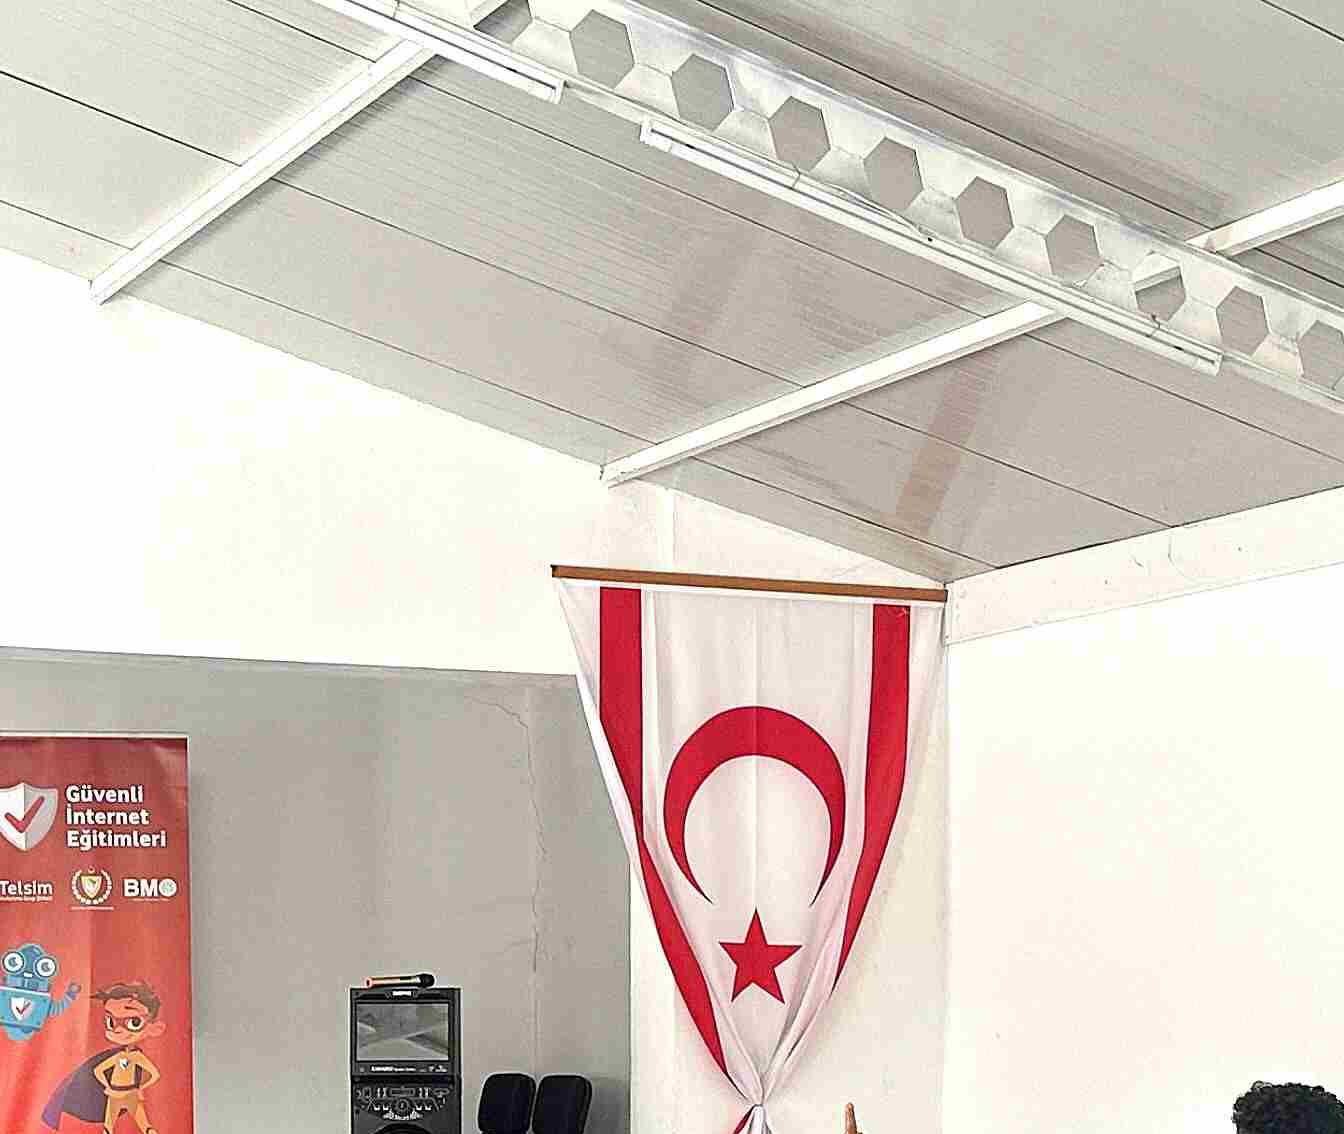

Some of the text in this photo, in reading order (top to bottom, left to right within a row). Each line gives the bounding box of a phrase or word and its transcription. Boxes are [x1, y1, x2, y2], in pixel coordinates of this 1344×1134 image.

[65, 785, 144, 803] Güvenli
[66, 803, 150, 825] İnternet
[66, 830, 168, 851] Eğitimleri
[123, 878, 178, 897] BMO
